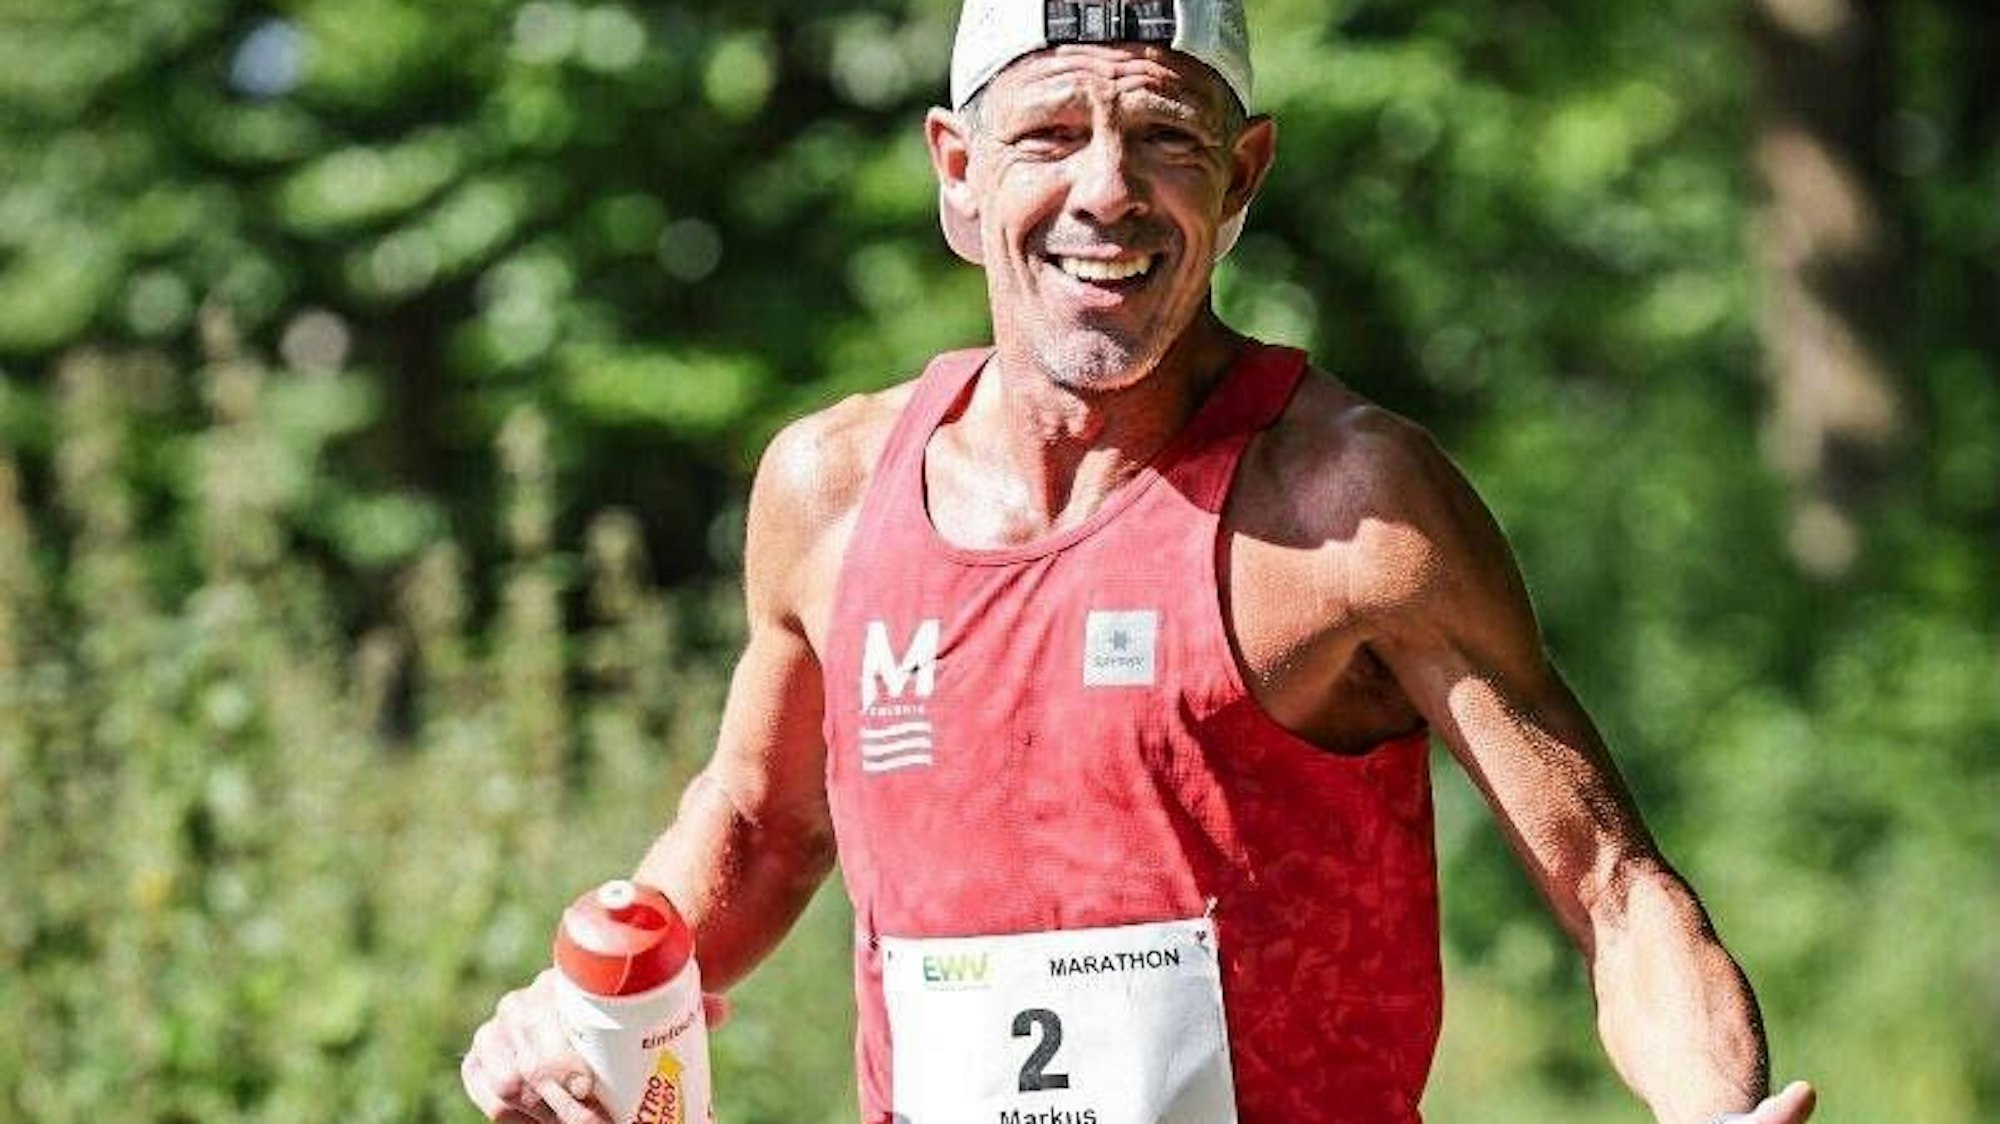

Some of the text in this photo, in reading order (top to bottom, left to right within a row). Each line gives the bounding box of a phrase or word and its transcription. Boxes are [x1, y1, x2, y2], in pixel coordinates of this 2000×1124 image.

[862, 619, 940, 711] M
[922, 953, 989, 982] EWV
[1050, 948, 1180, 977] MARATHON
[1011, 1008, 1069, 1092] 2
[1000, 1105, 1097, 1124] Markus
